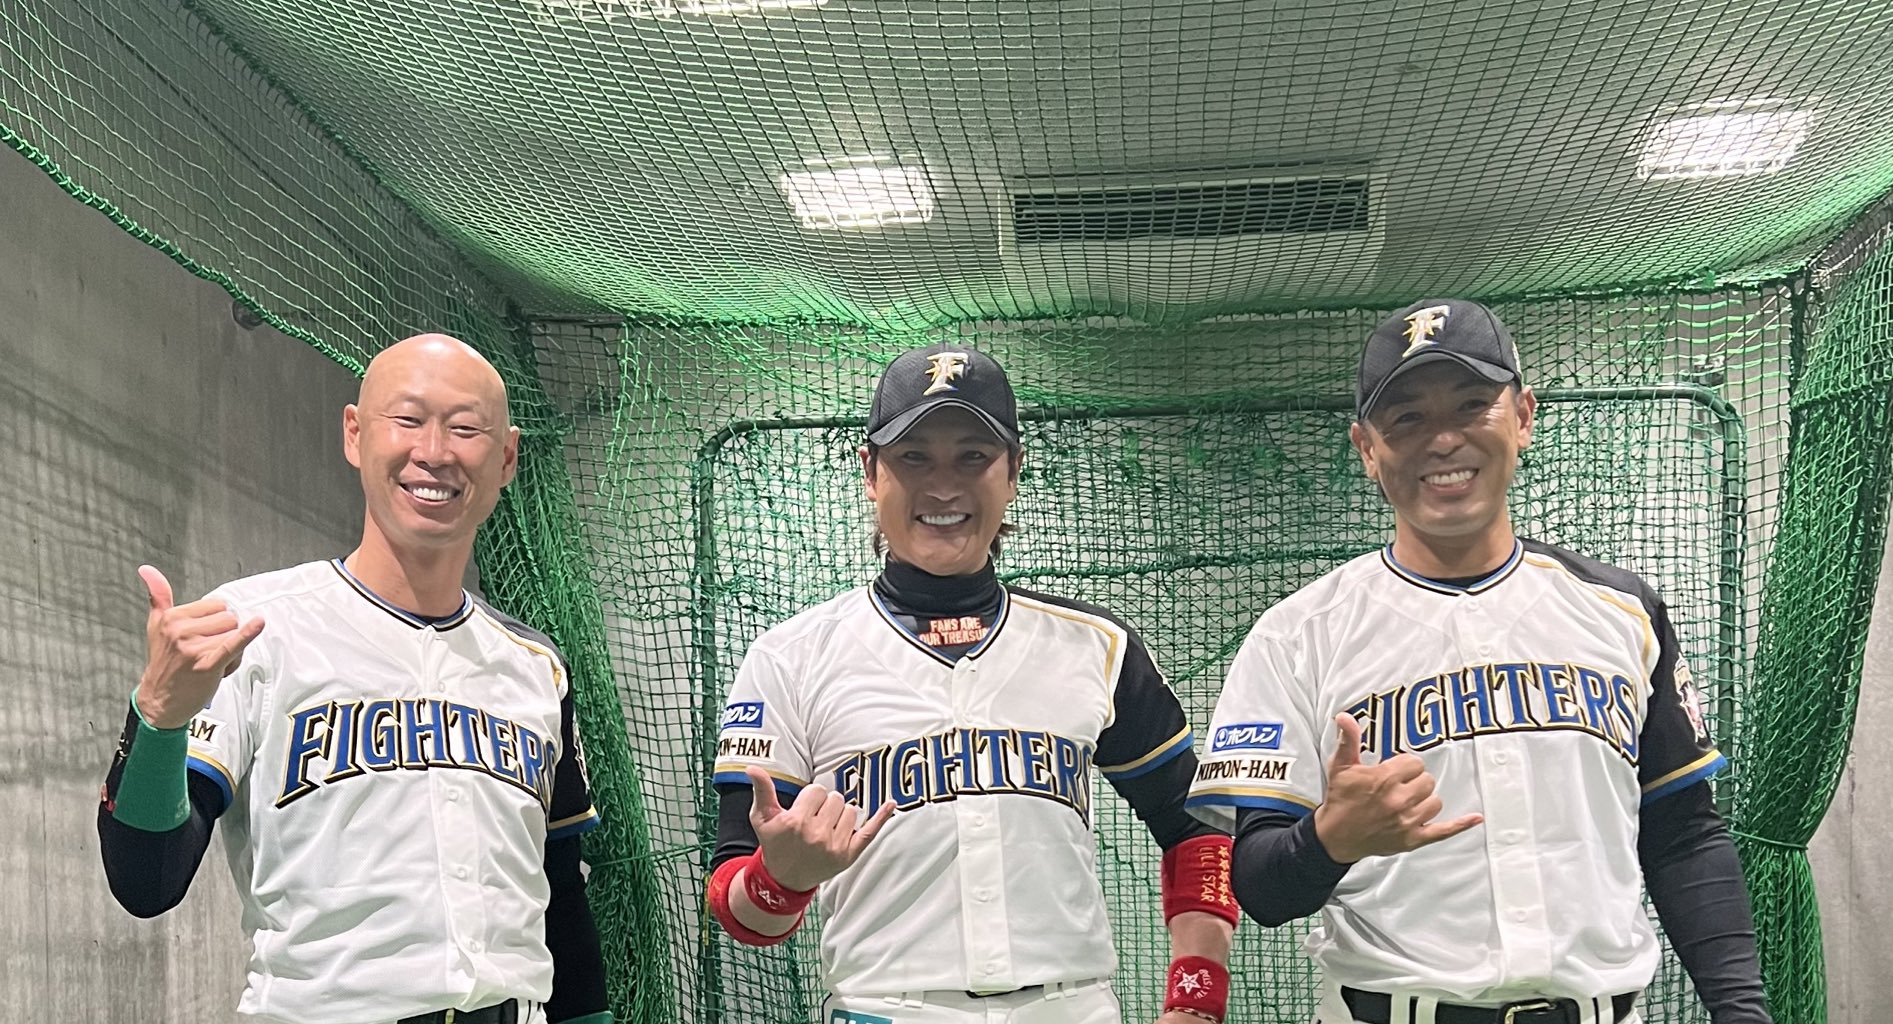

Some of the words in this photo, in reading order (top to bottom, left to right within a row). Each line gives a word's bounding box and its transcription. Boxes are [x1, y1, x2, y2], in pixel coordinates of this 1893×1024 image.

[1402, 305, 1451, 358] F
[923, 352, 969, 396] F
[930, 618, 958, 632] FANS
[960, 616, 981, 630] ARE
[1227, 727, 1277, 746] ホクレン
[1196, 760, 1290, 782] NIPPON-HAM
